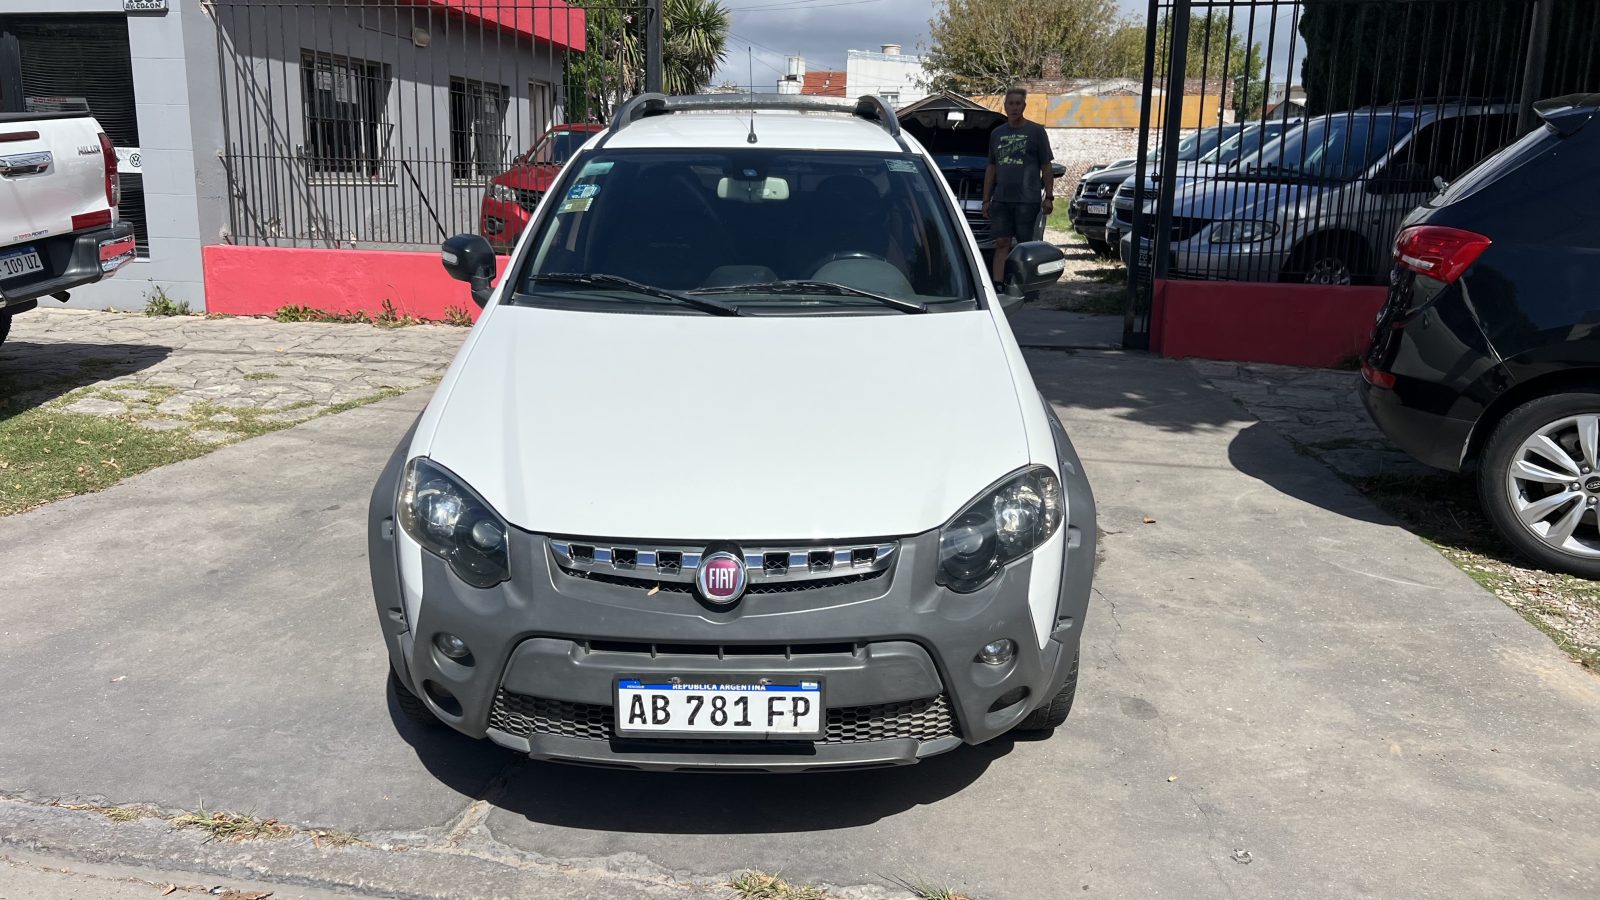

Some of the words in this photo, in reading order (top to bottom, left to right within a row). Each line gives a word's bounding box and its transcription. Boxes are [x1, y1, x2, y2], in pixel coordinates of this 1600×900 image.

[4, 257, 24, 275] 109
[25, 254, 40, 269] UZ
[709, 567, 736, 589] FIAT
[628, 694, 671, 725] AB
[686, 695, 752, 727] 781
[767, 696, 811, 727] FP
